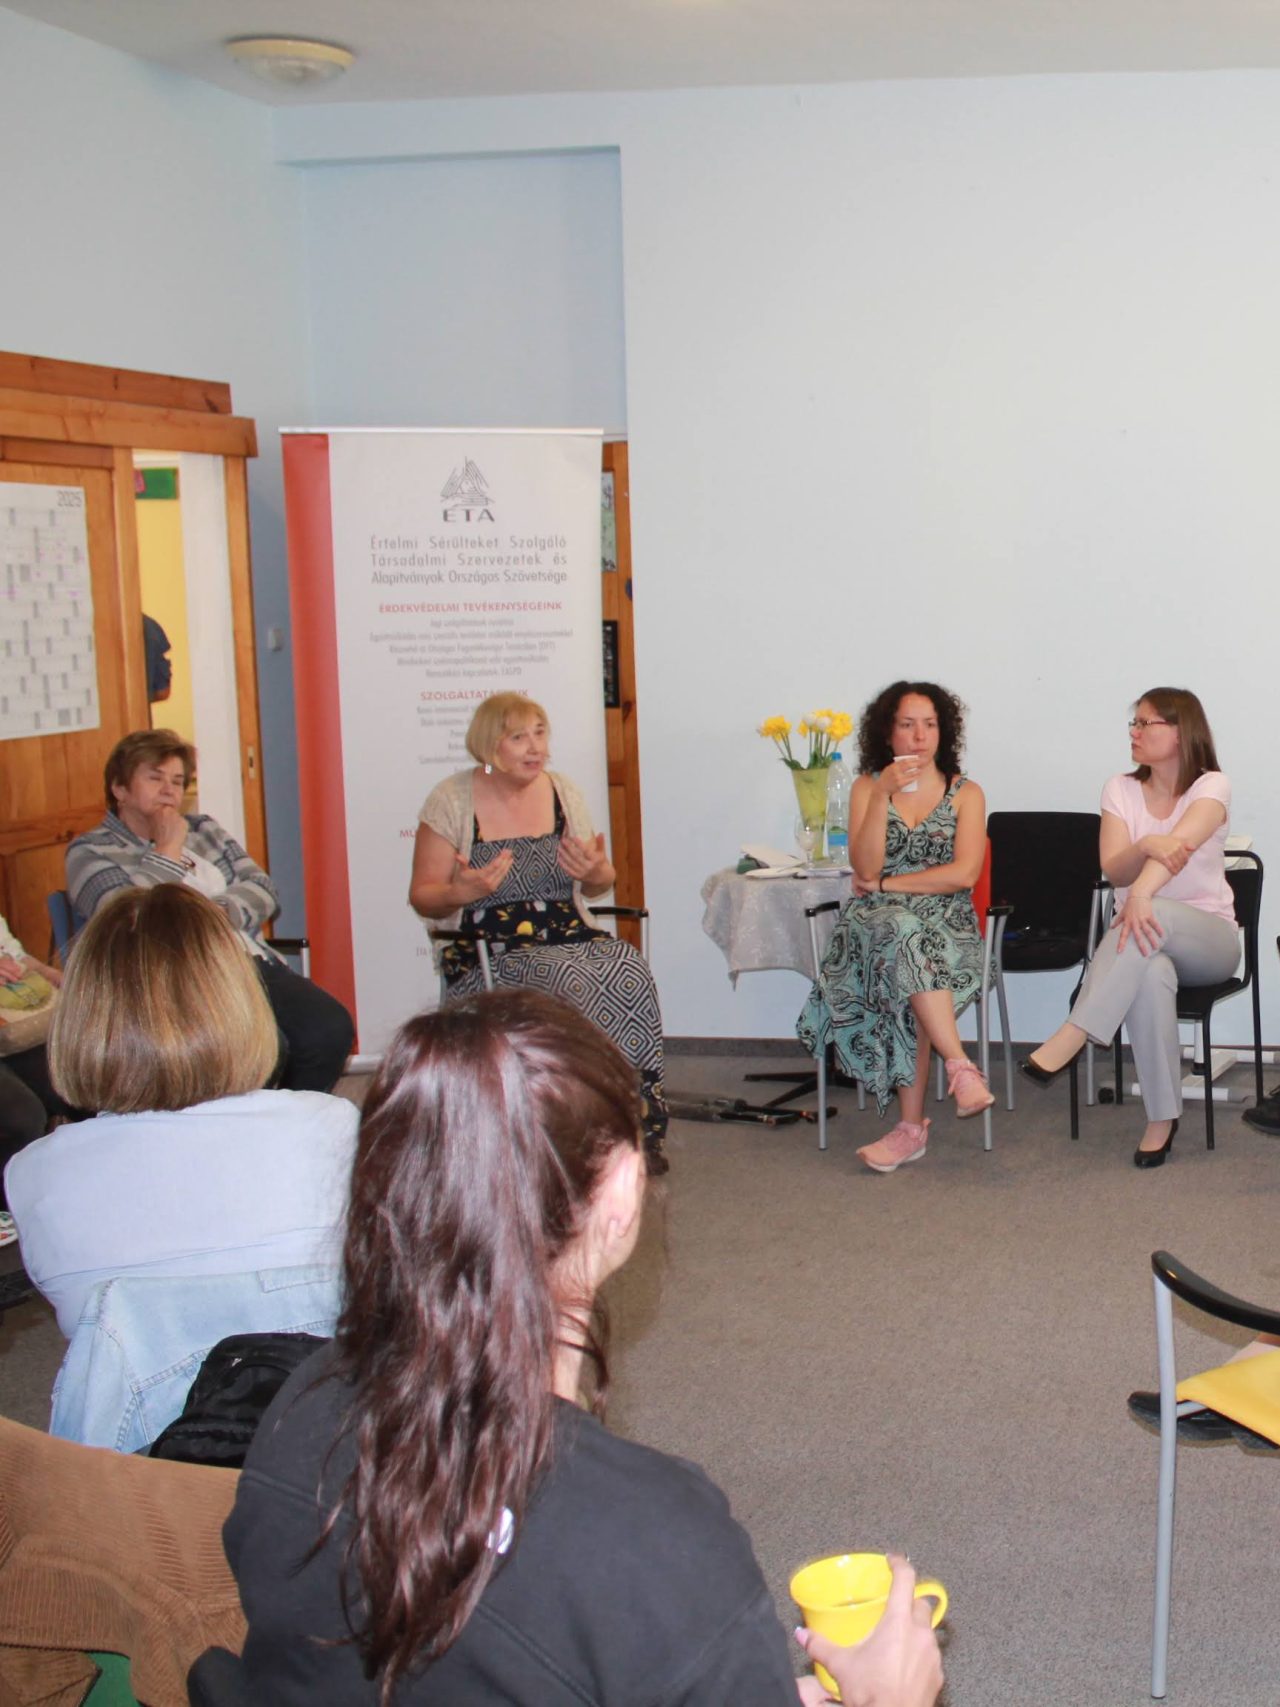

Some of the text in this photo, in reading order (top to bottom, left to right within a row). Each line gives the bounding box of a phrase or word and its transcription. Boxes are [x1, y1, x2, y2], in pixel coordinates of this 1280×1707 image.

[57, 491, 83, 507] 2025
[370, 534, 566, 551] Értelmi Sérülteket Szolgáló
[371, 553, 567, 566] Társadalmi Szervezetek és
[371, 570, 567, 586] Alapítványok Országos Szövetsége
